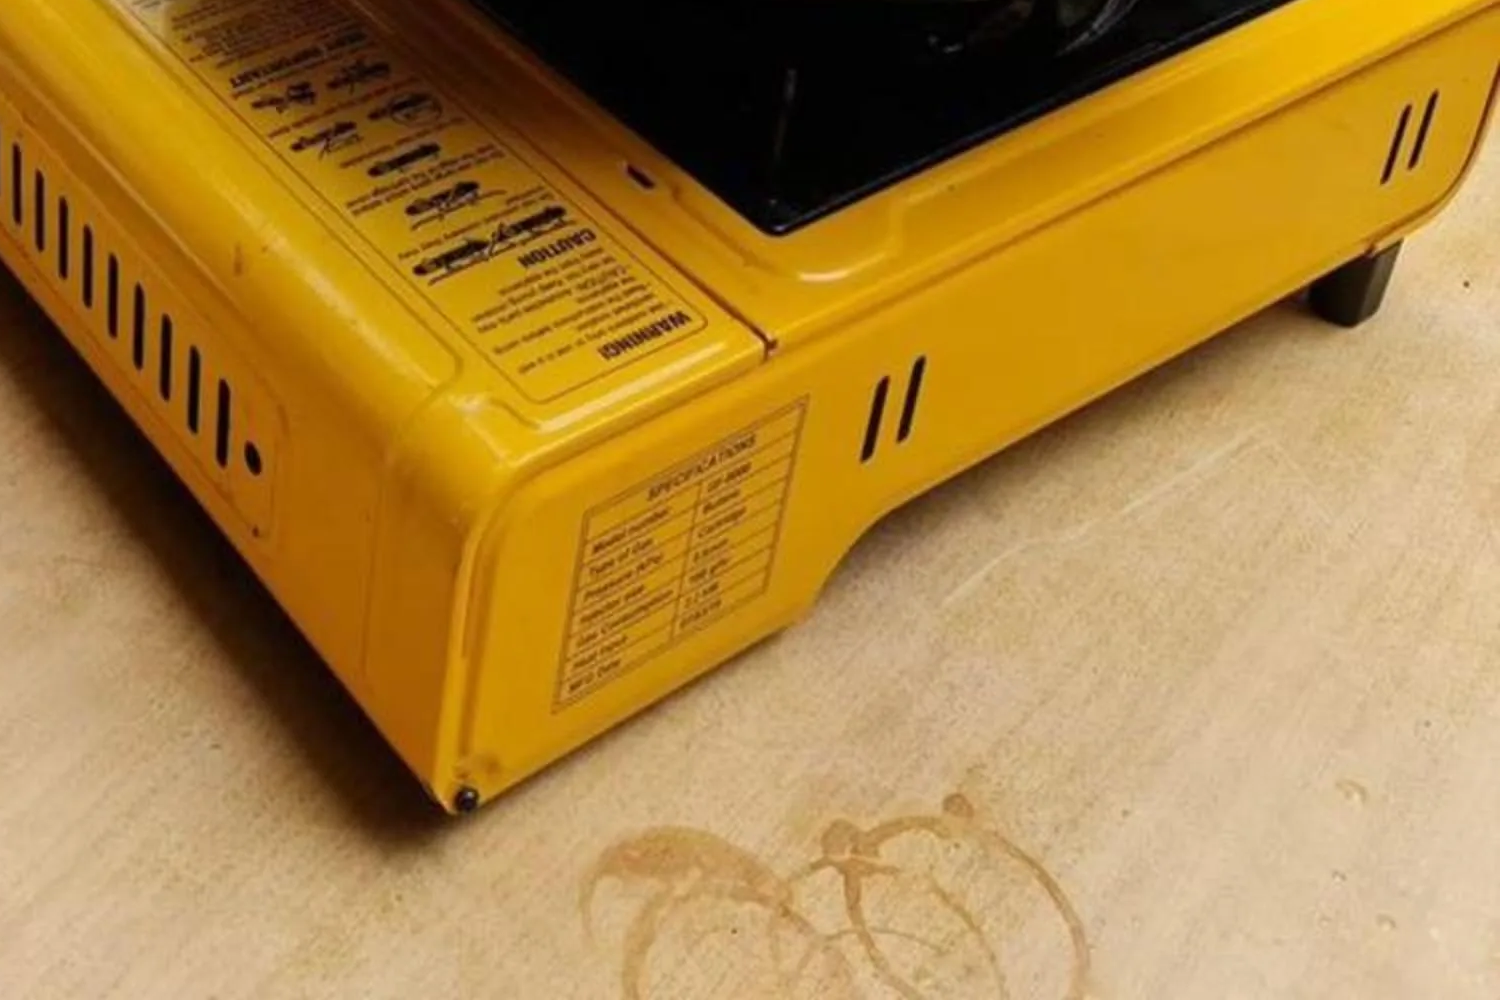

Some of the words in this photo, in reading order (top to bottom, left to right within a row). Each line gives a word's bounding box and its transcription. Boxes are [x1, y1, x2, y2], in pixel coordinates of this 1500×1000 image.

[517, 230, 596, 266] CAUTION
[597, 312, 691, 358] WARNING!
[648, 433, 756, 500] SPECIFICATIONS
